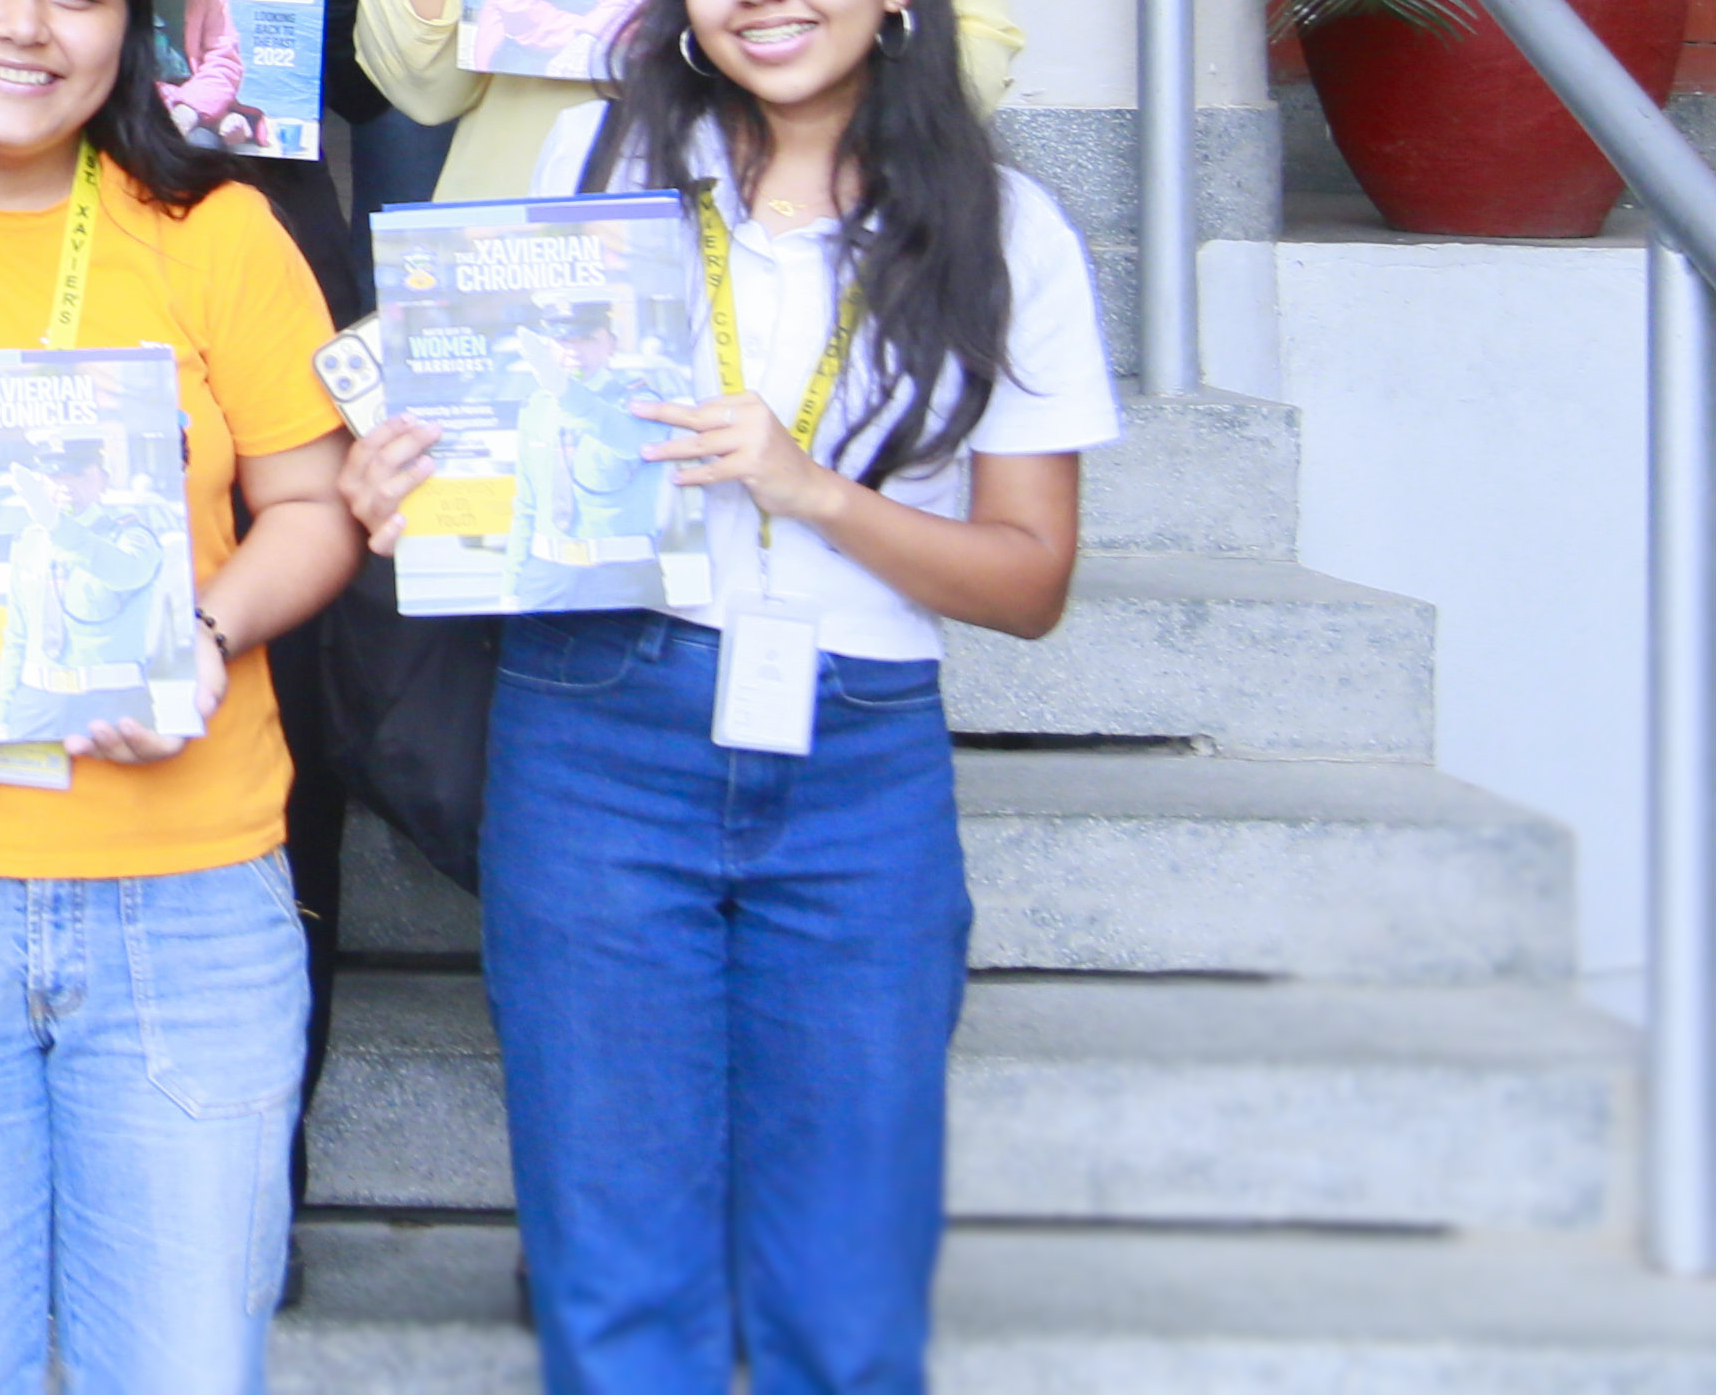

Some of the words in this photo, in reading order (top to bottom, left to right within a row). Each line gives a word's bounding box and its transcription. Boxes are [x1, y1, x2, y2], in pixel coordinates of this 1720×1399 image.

[253, 48, 295, 67] 2022
[454, 252, 475, 264] THE
[474, 236, 602, 264] XAVIERIAN
[458, 262, 605, 292] CHRONICLES
[409, 335, 486, 359] WOMEN
